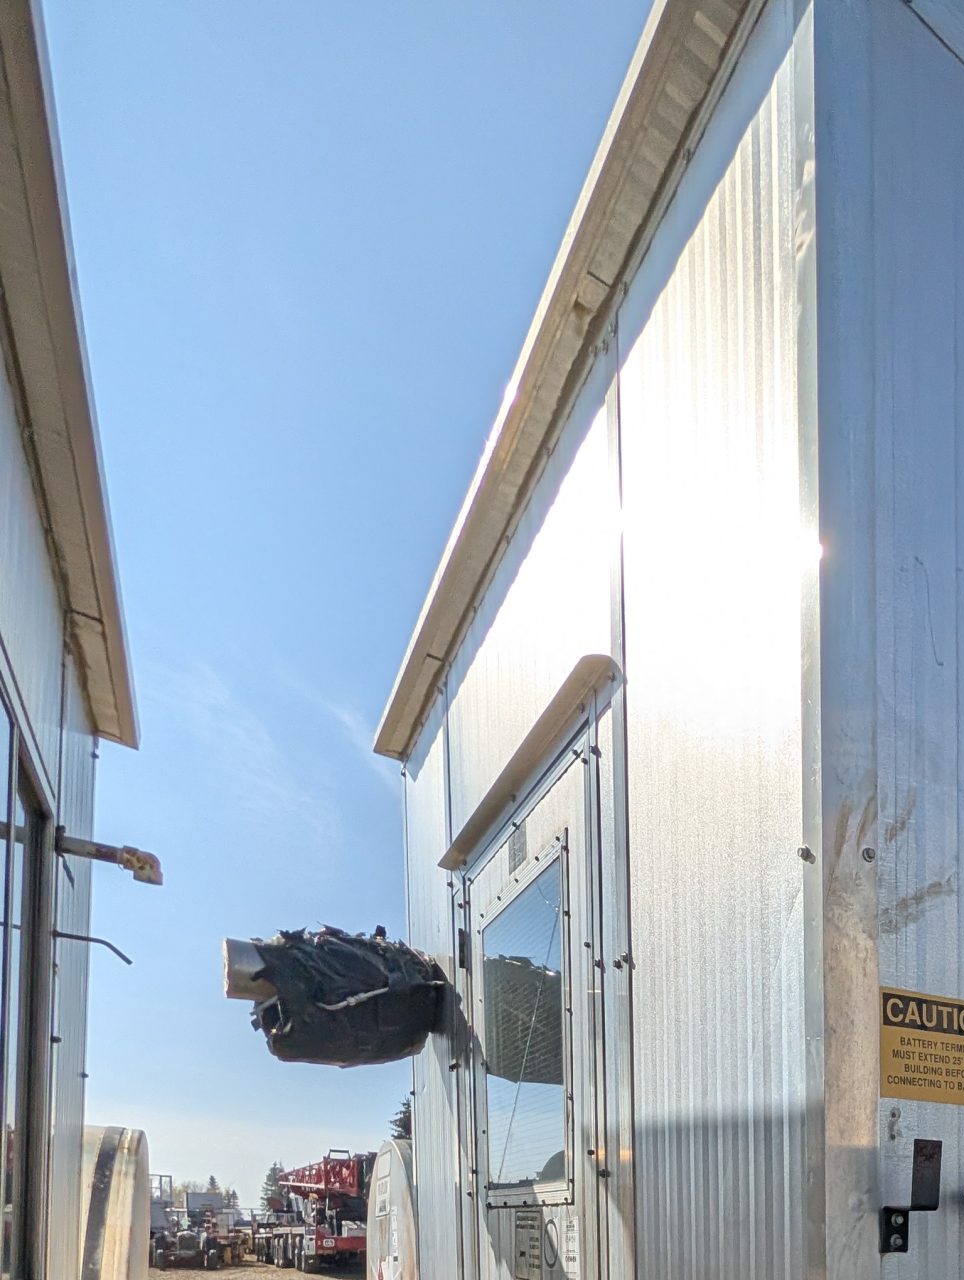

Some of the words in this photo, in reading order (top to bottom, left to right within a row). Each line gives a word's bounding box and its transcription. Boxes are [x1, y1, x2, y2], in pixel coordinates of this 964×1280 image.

[900, 1036, 938, 1050] BATTERY
[892, 1049, 916, 1060] MUST
[918, 1052, 950, 1064] EXTEND
[904, 1063, 943, 1076] BUILDING
[887, 1074, 942, 1089] CONNECTING
[944, 1080, 955, 1090] TO
